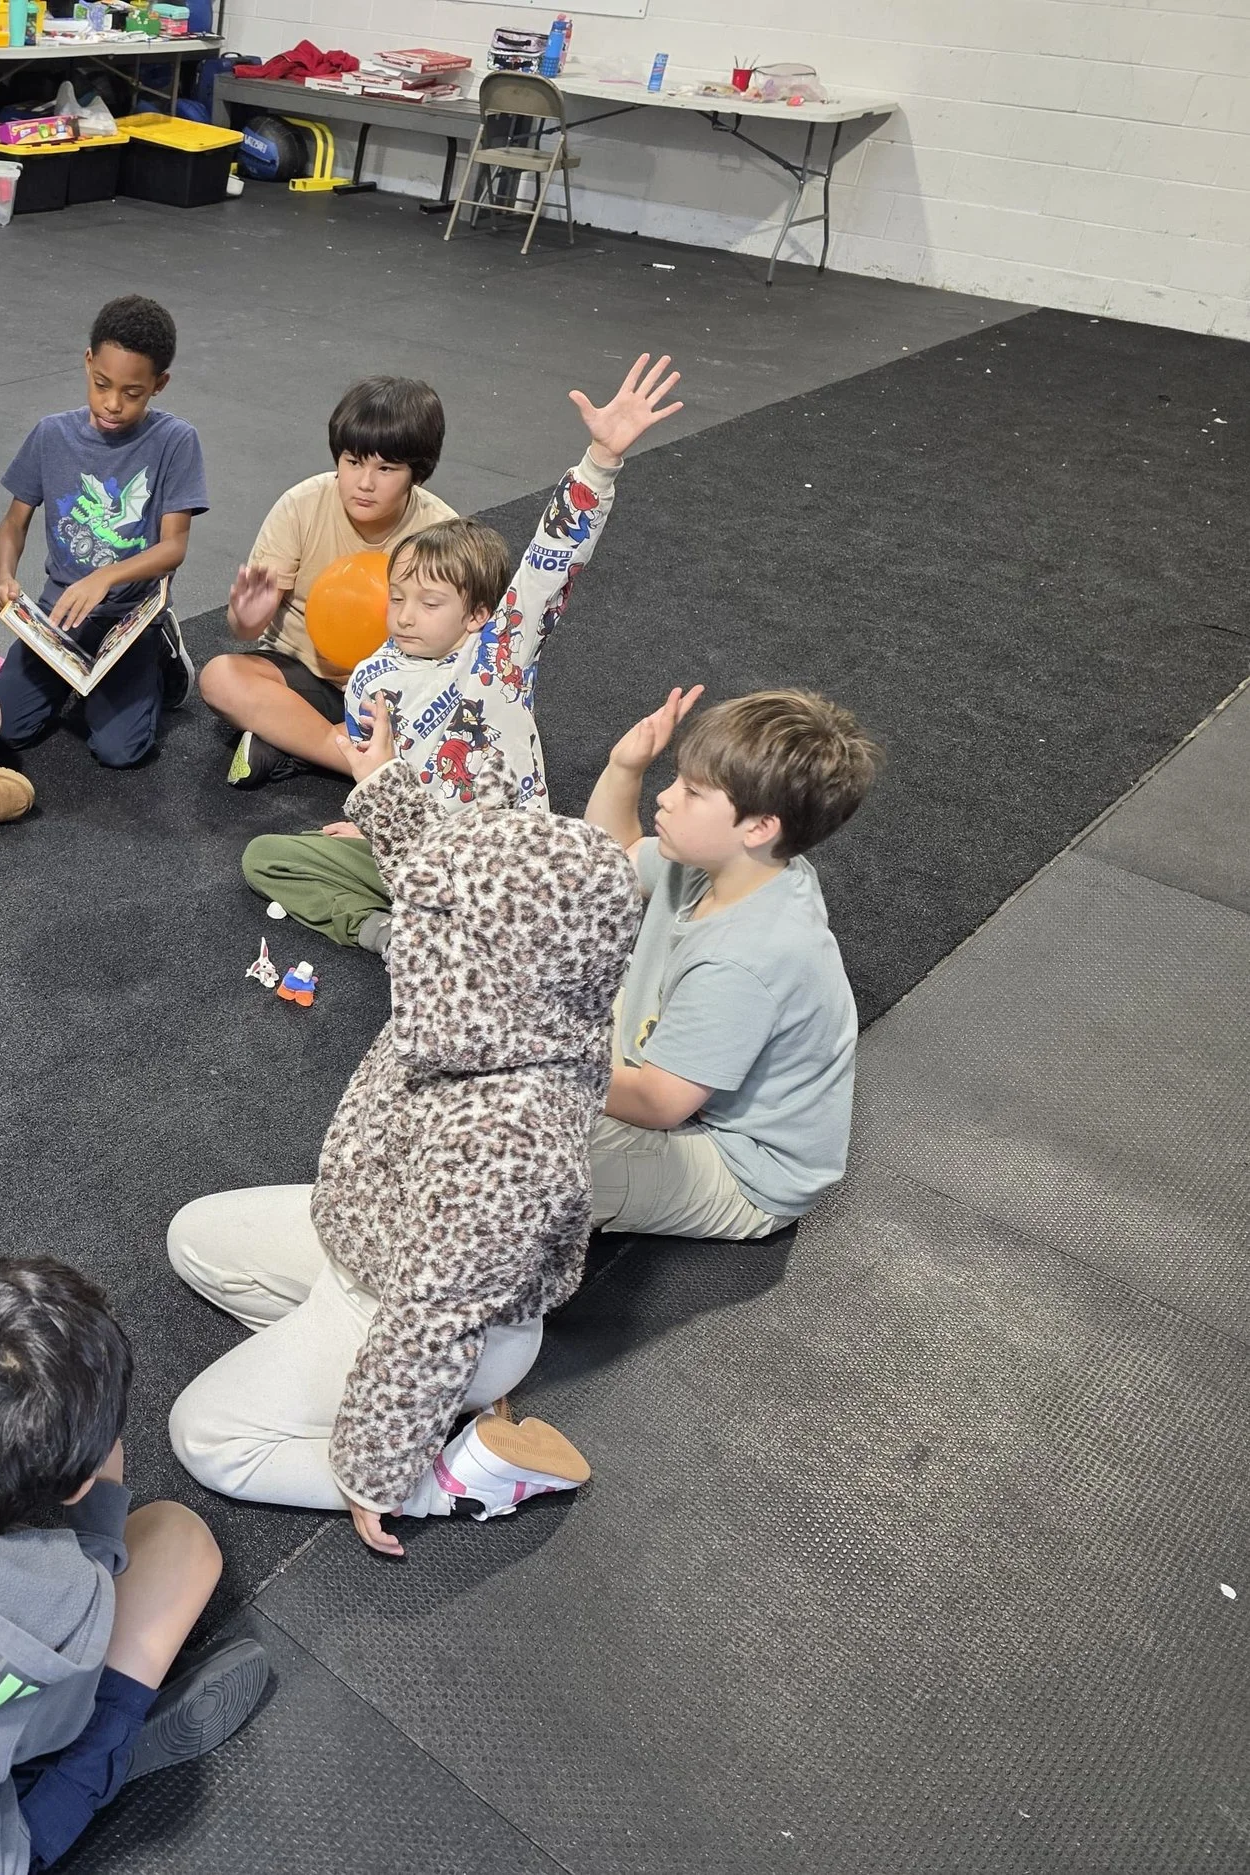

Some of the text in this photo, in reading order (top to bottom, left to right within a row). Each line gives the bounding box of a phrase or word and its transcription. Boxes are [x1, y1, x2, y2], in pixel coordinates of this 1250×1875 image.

[525, 551, 570, 572] SON
[351, 658, 394, 694] SONI
[412, 682, 460, 734] SONIC
